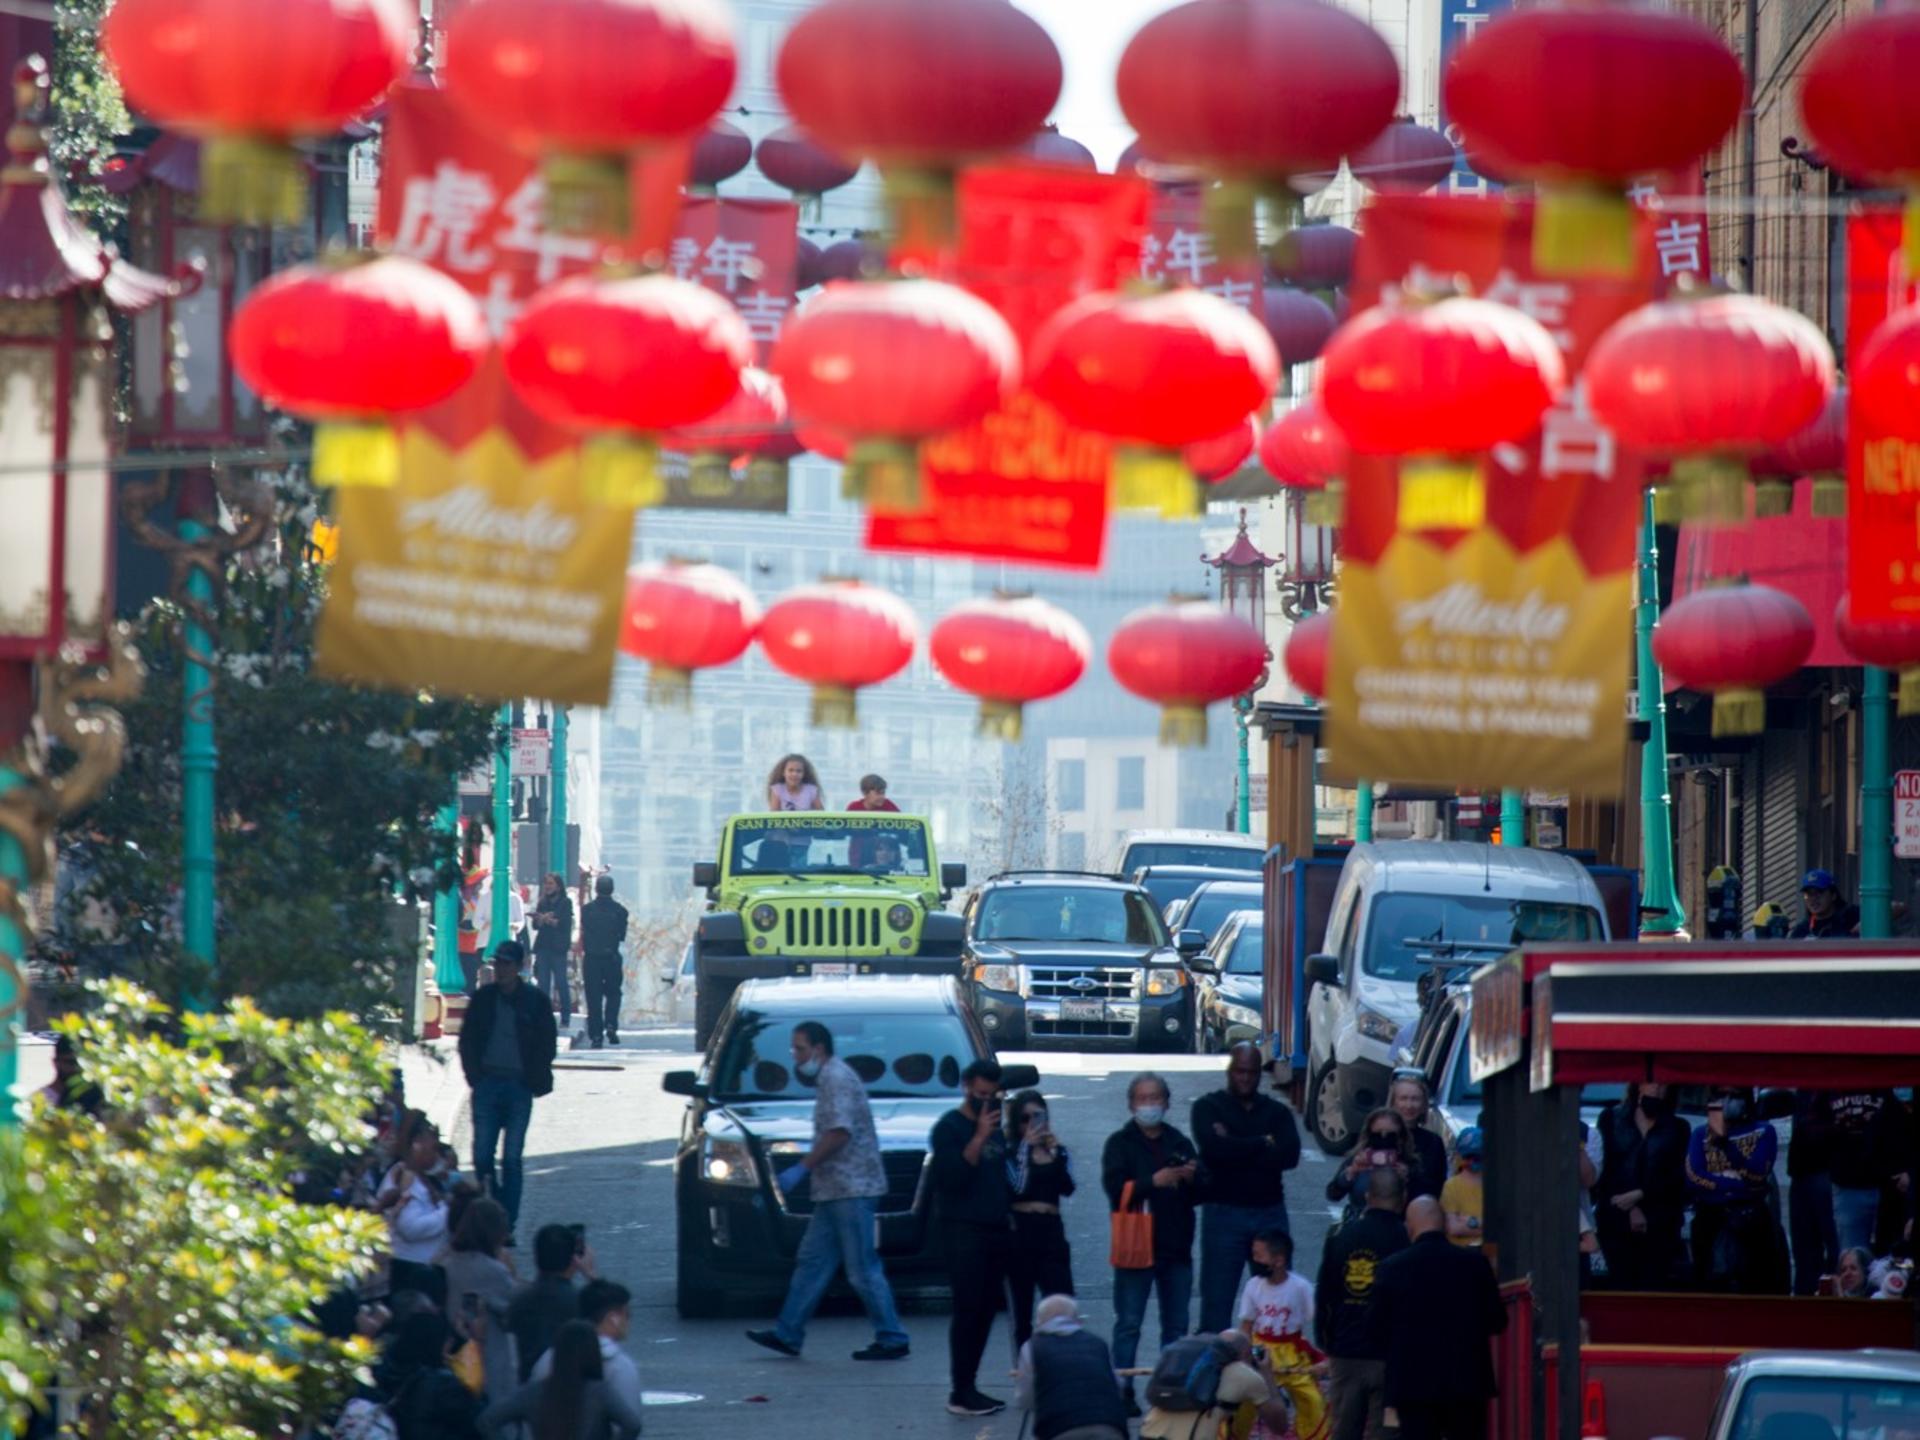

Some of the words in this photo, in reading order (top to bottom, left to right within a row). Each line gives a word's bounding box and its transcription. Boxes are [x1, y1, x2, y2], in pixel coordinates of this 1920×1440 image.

[736, 819, 764, 830] SAN
[767, 817, 844, 830] FRANCISCO
[845, 818, 874, 829] JEEP
[877, 818, 921, 830] TOURS
